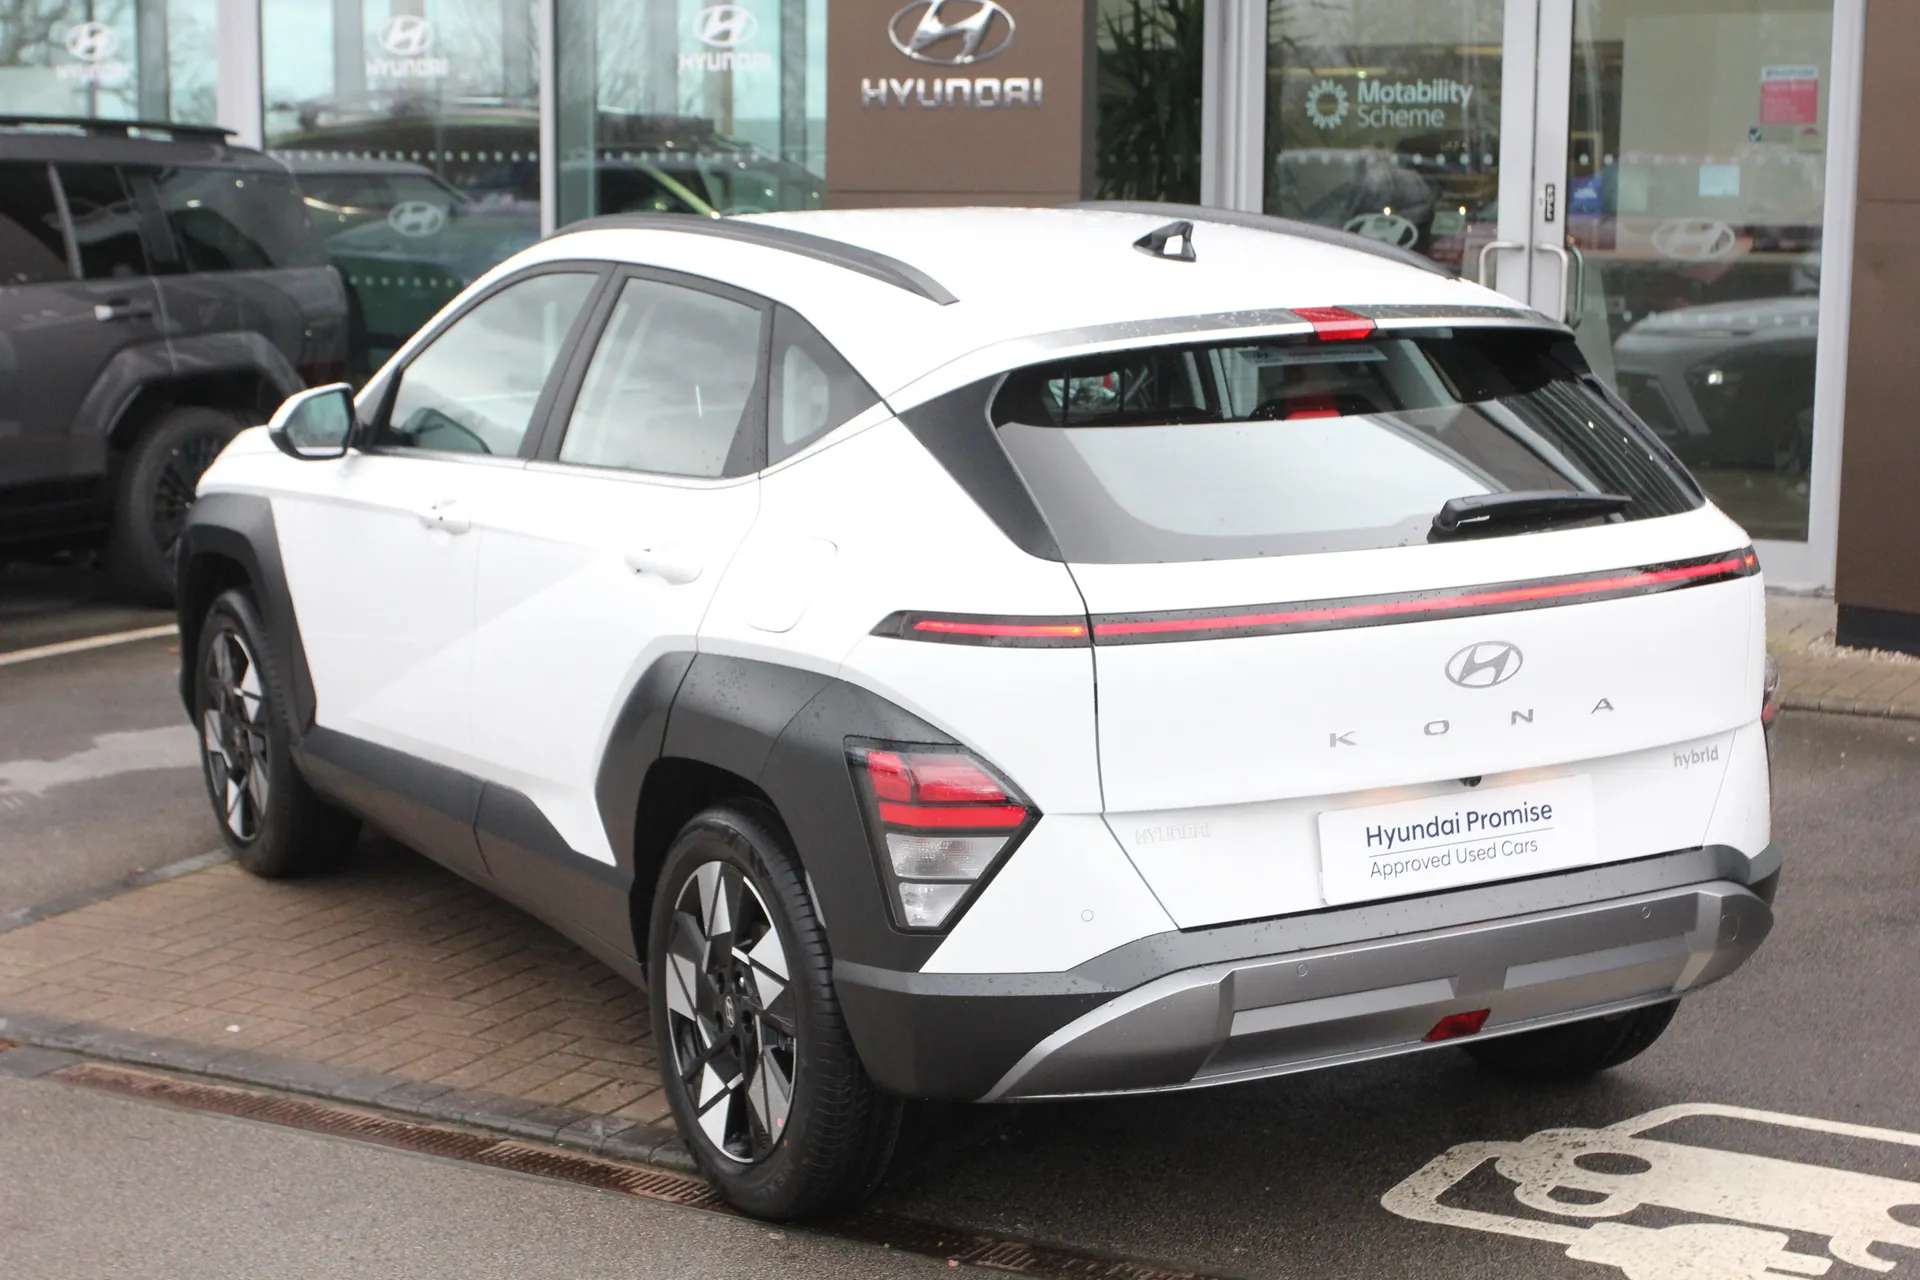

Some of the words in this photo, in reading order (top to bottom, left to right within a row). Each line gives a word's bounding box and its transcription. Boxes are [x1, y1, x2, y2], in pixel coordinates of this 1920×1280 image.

[861, 77, 1043, 108] HYUNDAI
[1358, 78, 1474, 112] Motability
[1357, 104, 1445, 128] Scheme
[1672, 743, 1719, 769] hybrid
[1366, 812, 1460, 849] Hyundai
[1466, 801, 1553, 832] Promise
[1370, 849, 1451, 880] Approved
[1455, 843, 1498, 864] Used
[1500, 838, 1539, 857] Cars
